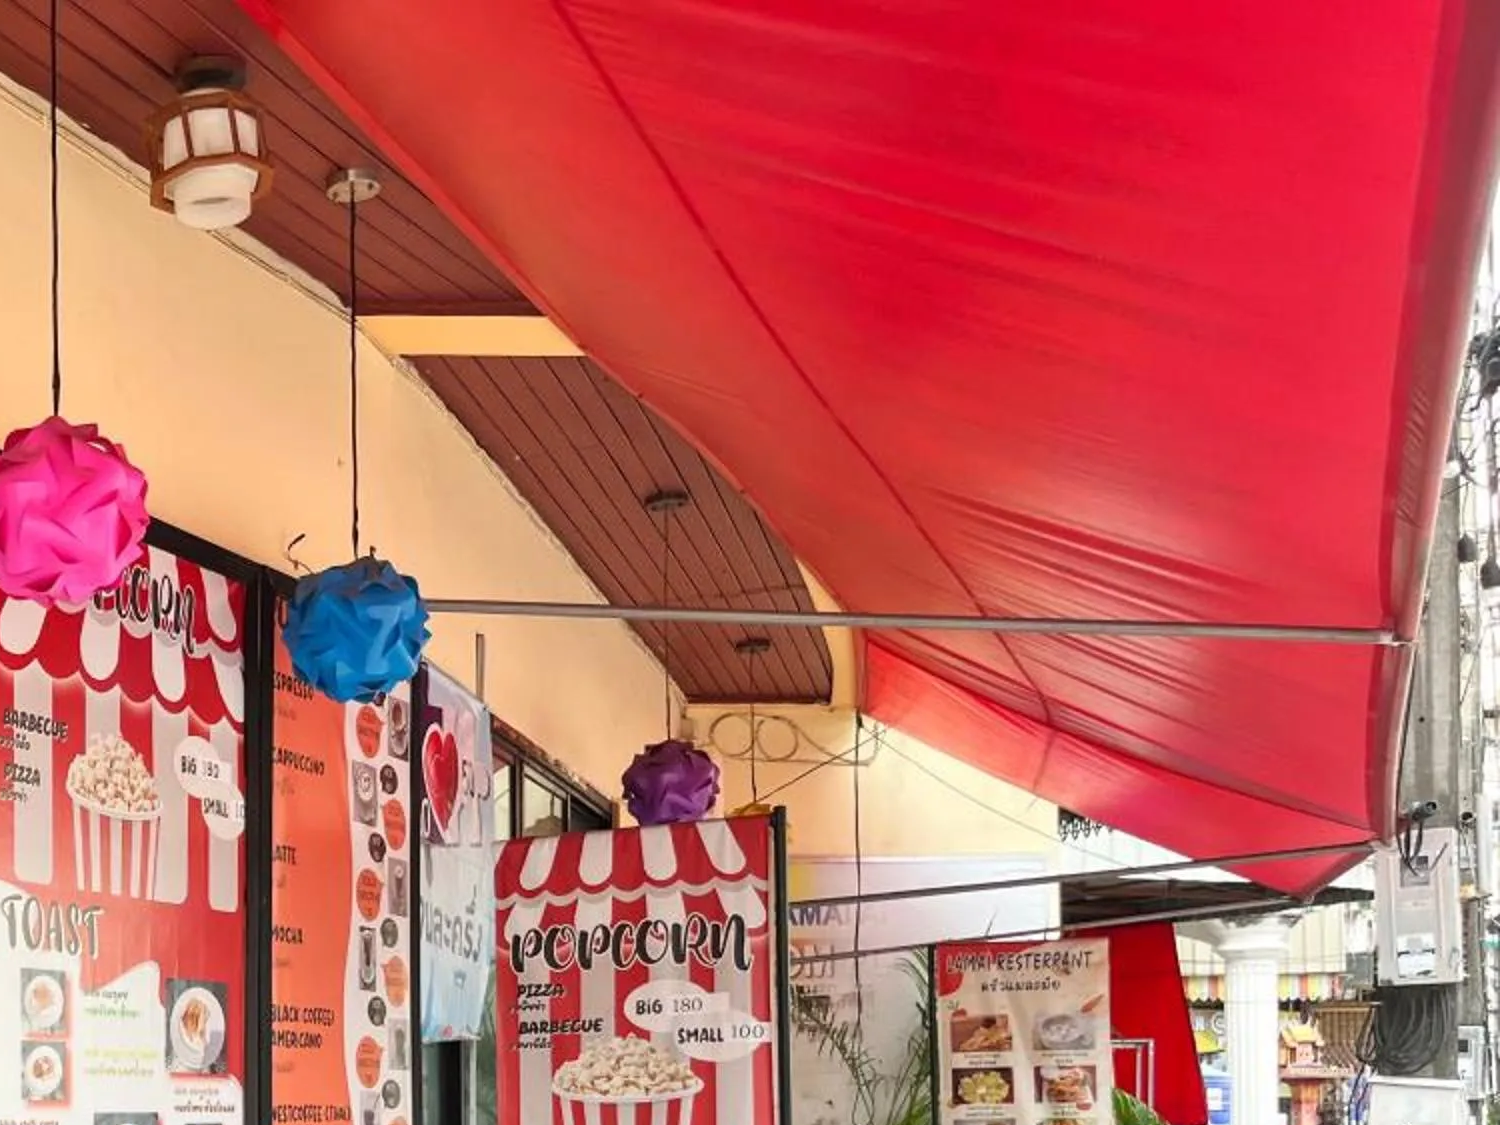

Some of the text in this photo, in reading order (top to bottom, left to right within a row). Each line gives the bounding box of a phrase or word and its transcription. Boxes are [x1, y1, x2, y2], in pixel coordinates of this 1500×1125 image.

[3, 707, 68, 740] BARBECUE
[3, 763, 41, 787] PIZZA
[0, 894, 105, 960] TOAST
[517, 983, 565, 999] PIZZA
[672, 998, 704, 1014] 180
[518, 1018, 604, 1035] BARBECUE
[677, 1023, 765, 1044] SMALL 100
